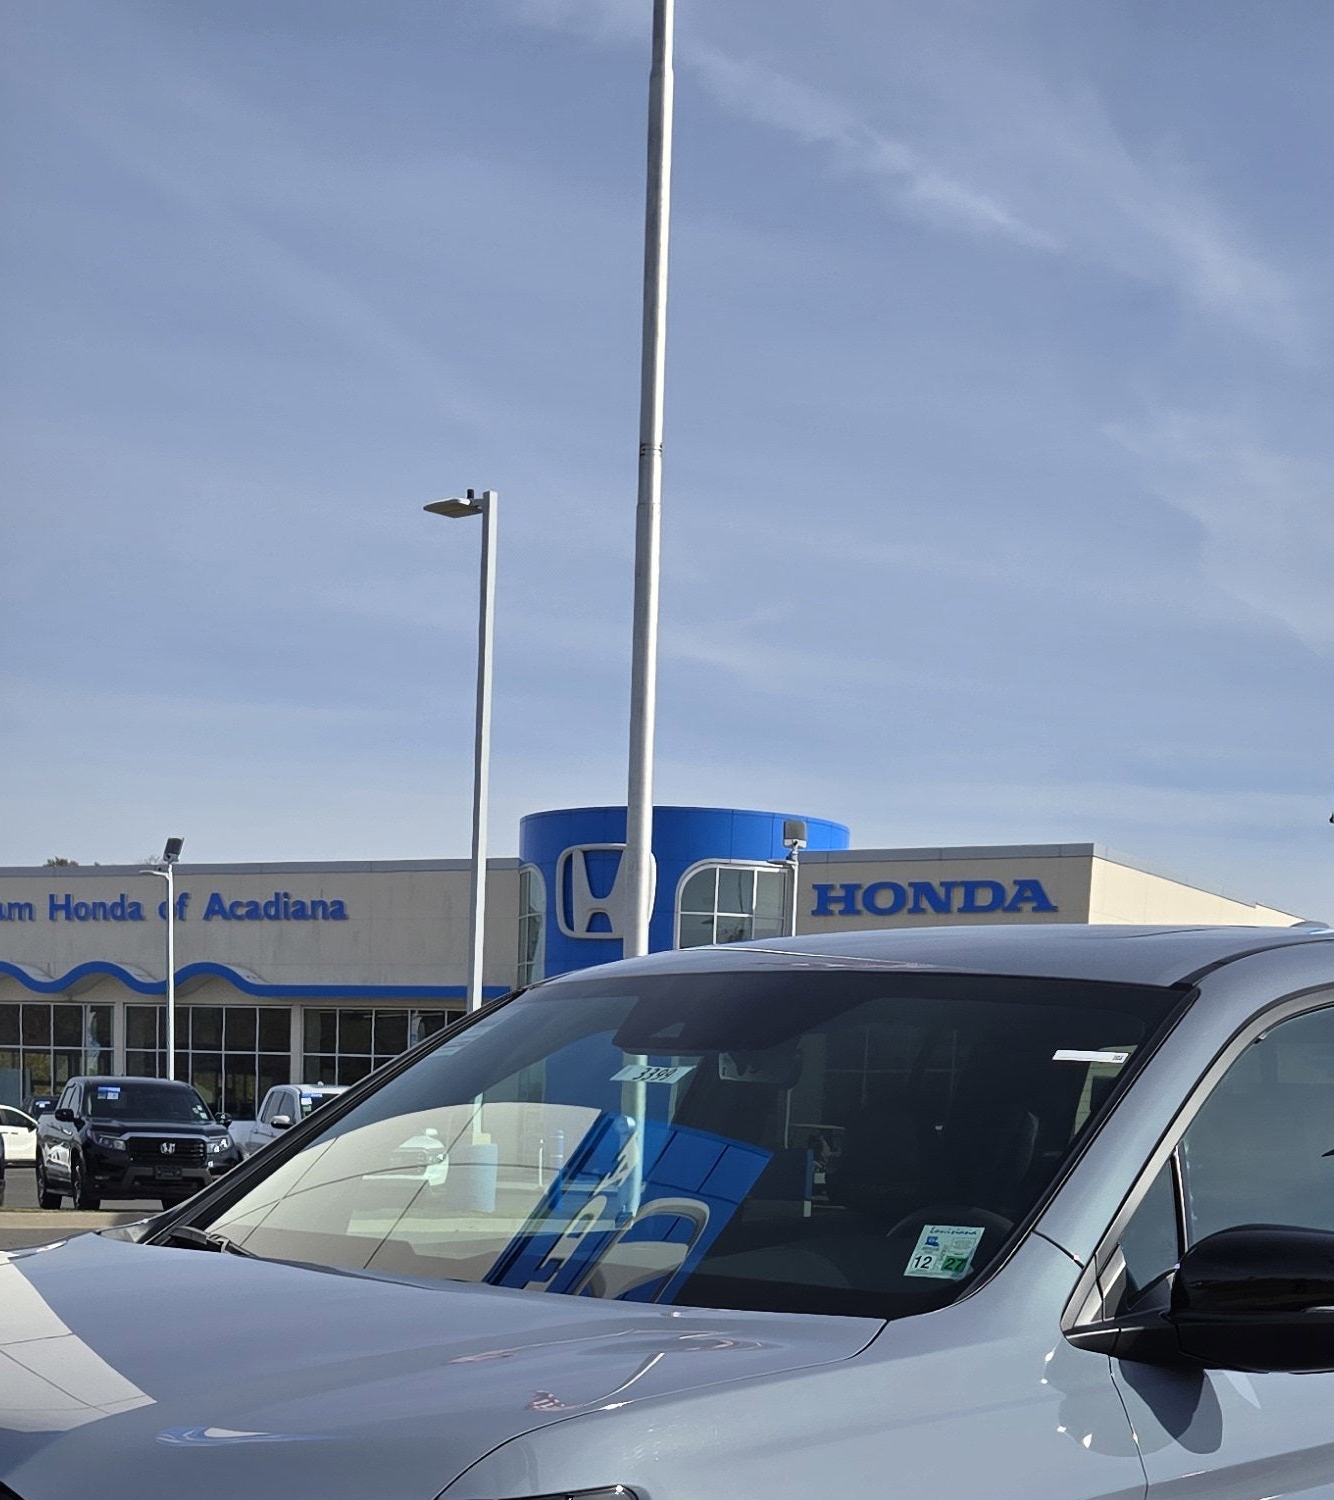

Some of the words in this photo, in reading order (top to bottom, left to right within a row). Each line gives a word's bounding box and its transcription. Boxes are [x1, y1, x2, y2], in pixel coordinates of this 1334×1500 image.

[48, 893, 146, 922] Honda
[158, 892, 192, 922] of
[202, 891, 349, 922] Acadiana
[810, 877, 1058, 917] HONDA
[913, 1255, 933, 1269] 12
[944, 1257, 968, 1271] 27
